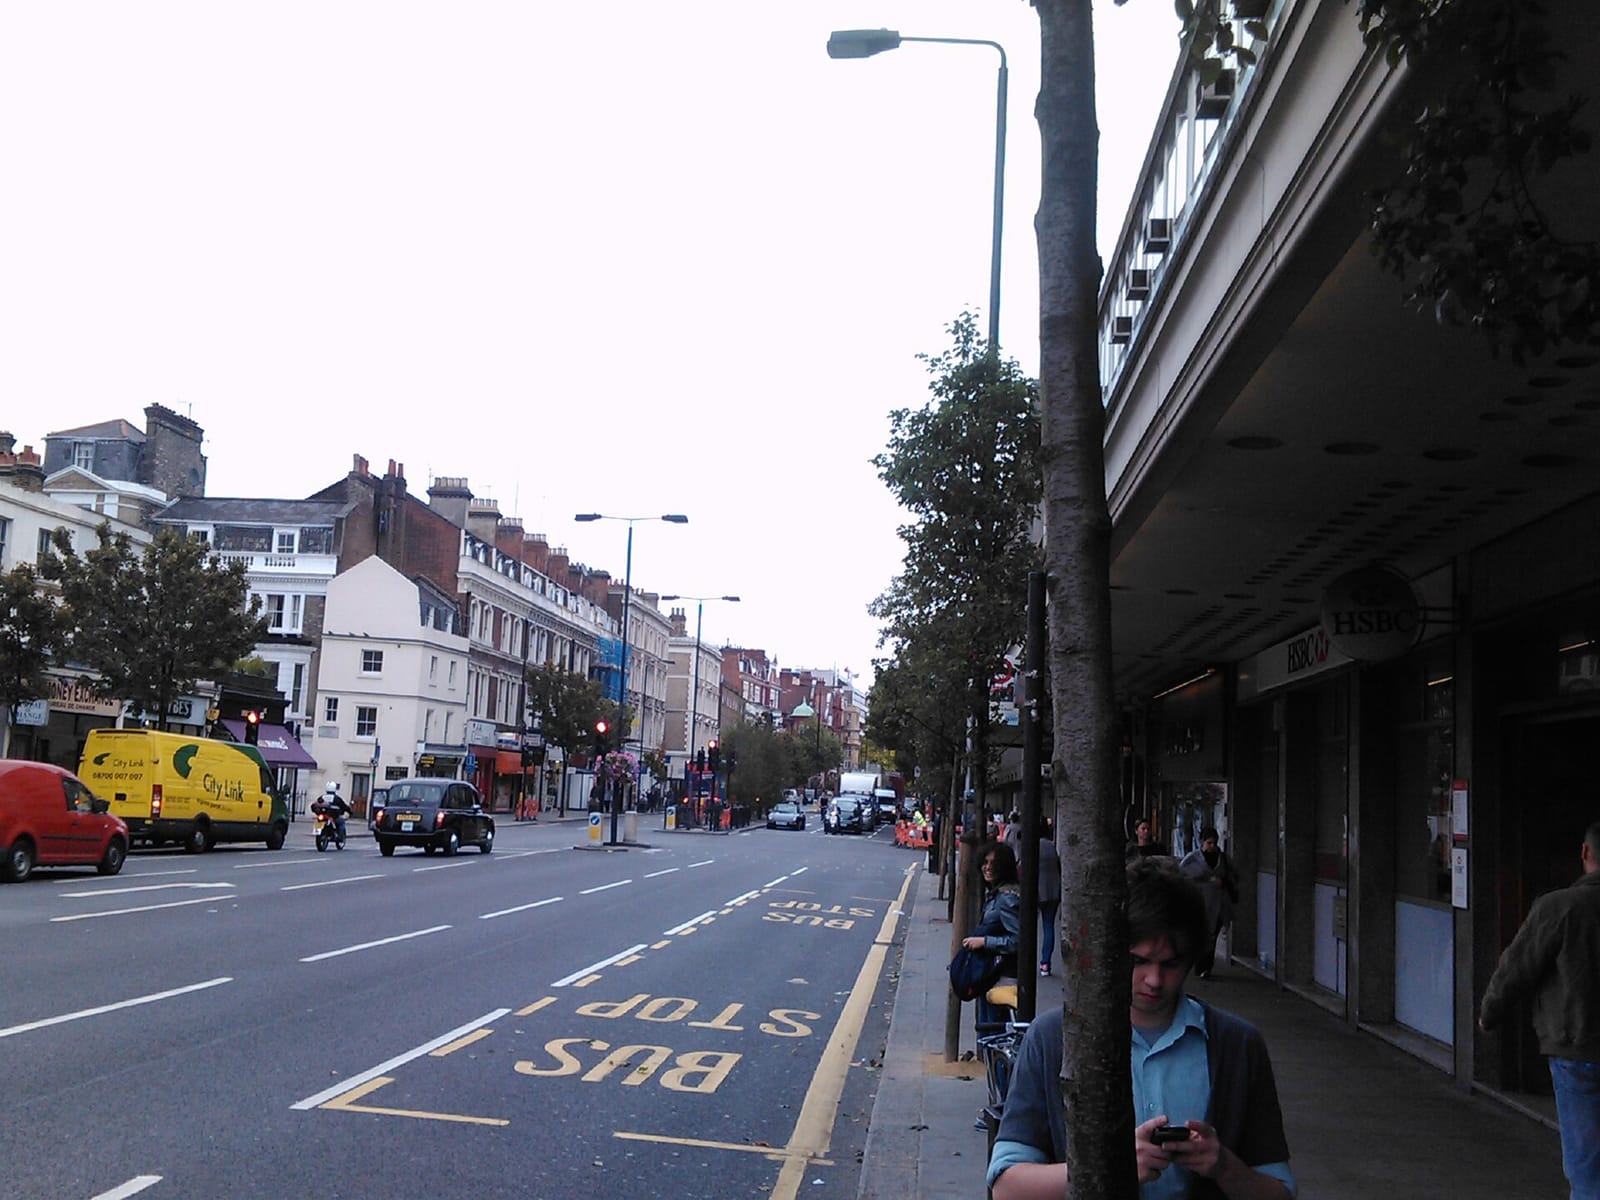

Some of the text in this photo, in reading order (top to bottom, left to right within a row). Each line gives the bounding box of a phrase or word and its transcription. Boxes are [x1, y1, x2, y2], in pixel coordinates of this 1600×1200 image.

[1332, 610, 1414, 635] HSBC
[1288, 634, 1314, 673] HSBC
[113, 758, 144, 769] City Link
[203, 773, 244, 802] City Link
[762, 911, 855, 930] BUS
[769, 900, 876, 917] STOP
[576, 993, 822, 1038] STOP
[514, 1038, 743, 1094] BUS
